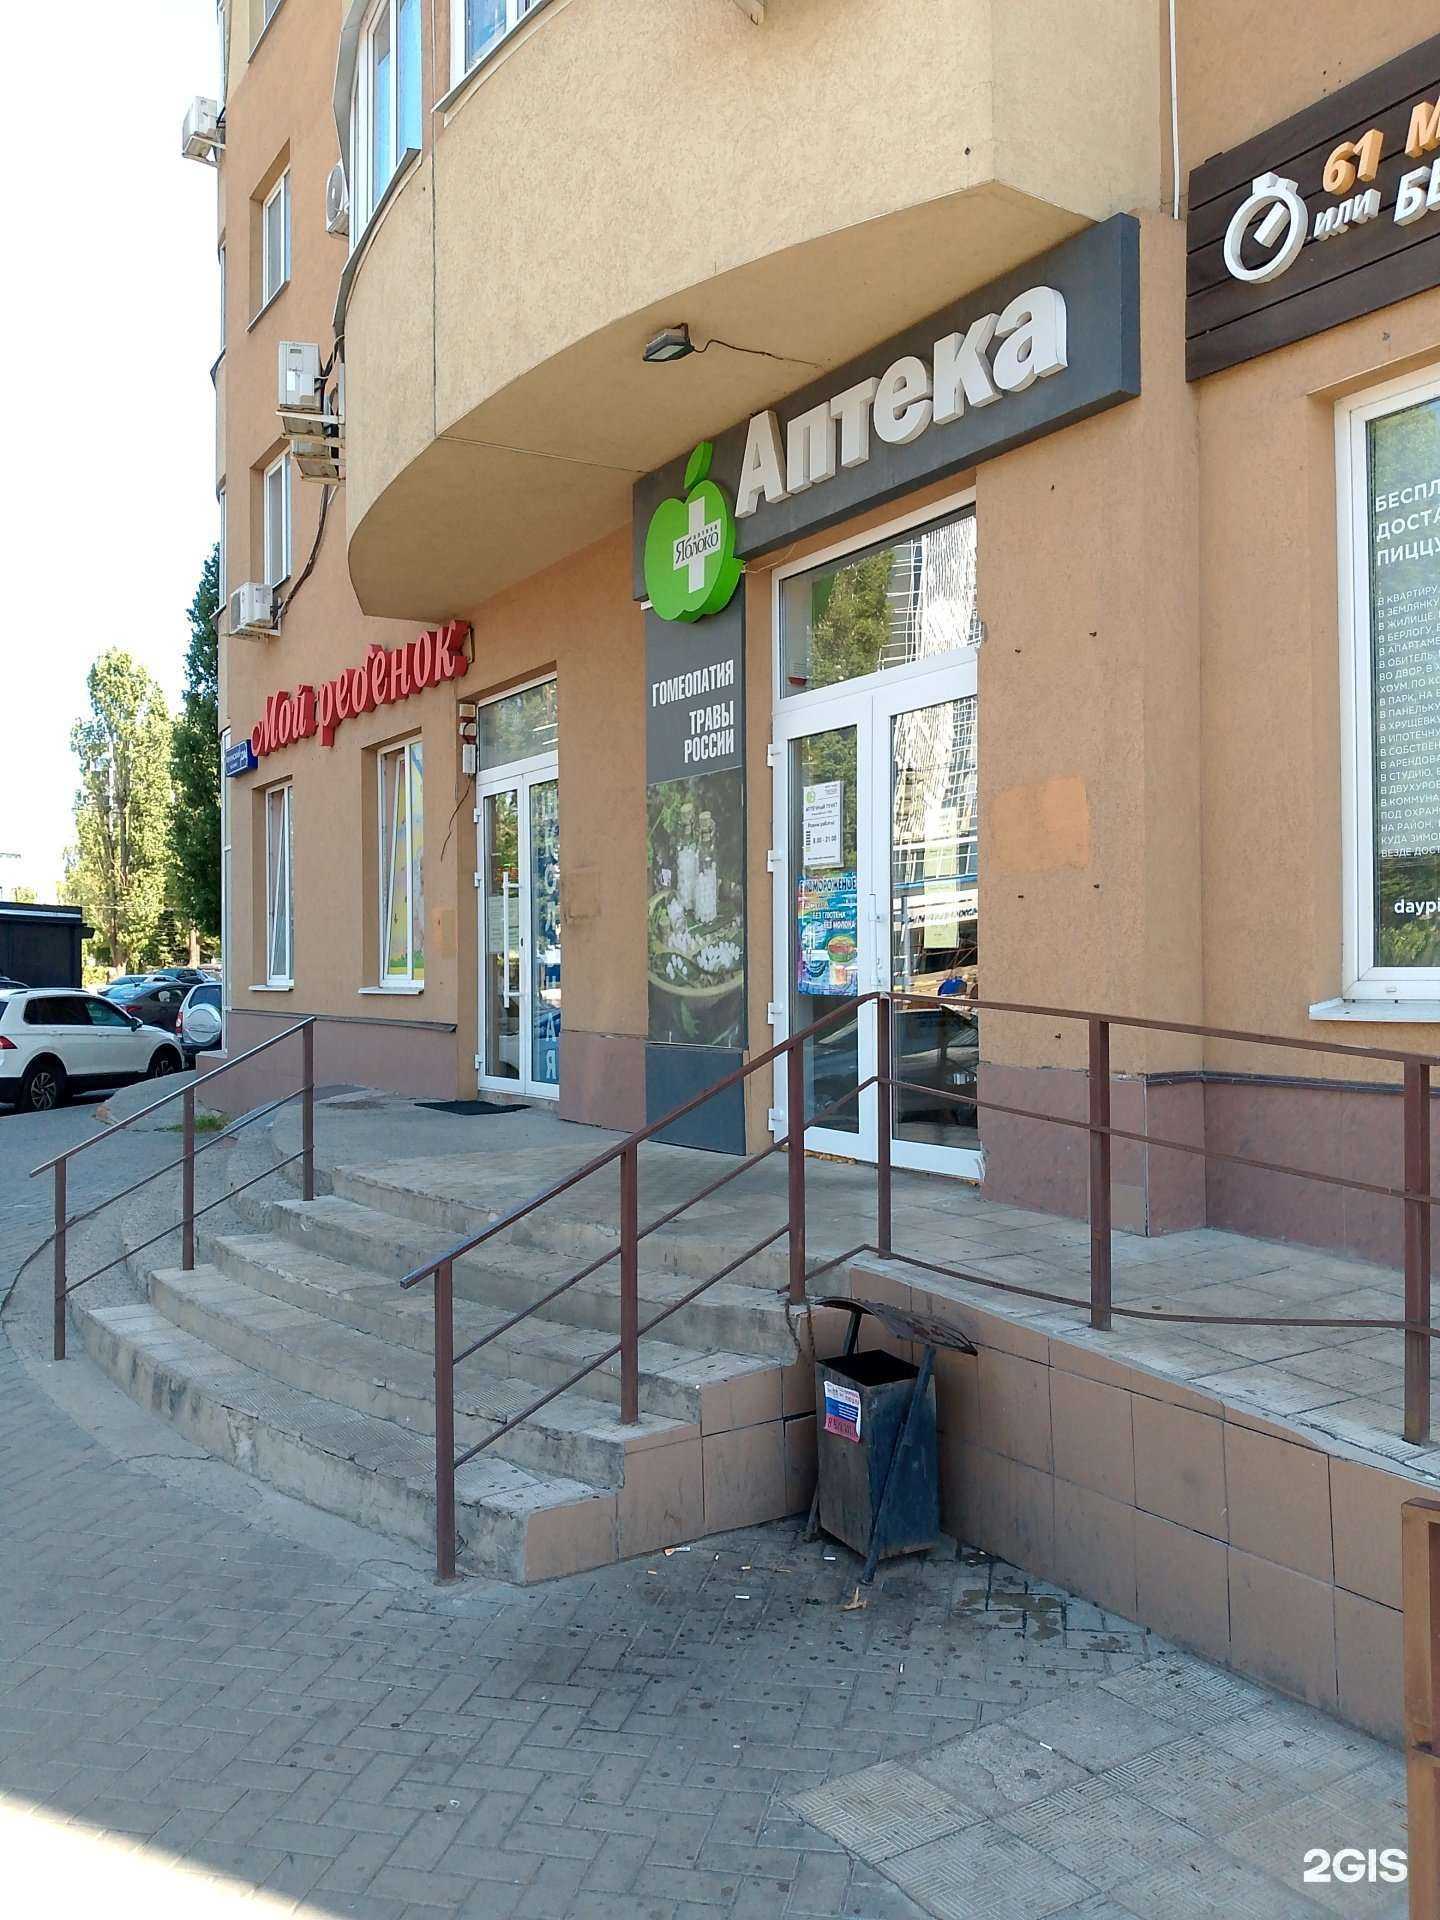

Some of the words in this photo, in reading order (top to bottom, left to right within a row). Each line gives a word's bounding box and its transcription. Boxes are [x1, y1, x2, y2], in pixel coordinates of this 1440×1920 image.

[1323, 128, 1384, 196] 61
[1313, 188, 1382, 242] или
[735, 286, 1068, 519] Аптека
[675, 531, 719, 564] Яблоко
[652, 659, 734, 707] ГОМЕОПАТИЯ
[250, 684, 317, 758] Мой
[688, 700, 734, 735] ТРАВЫ
[684, 728, 734, 763] РОССИИ
